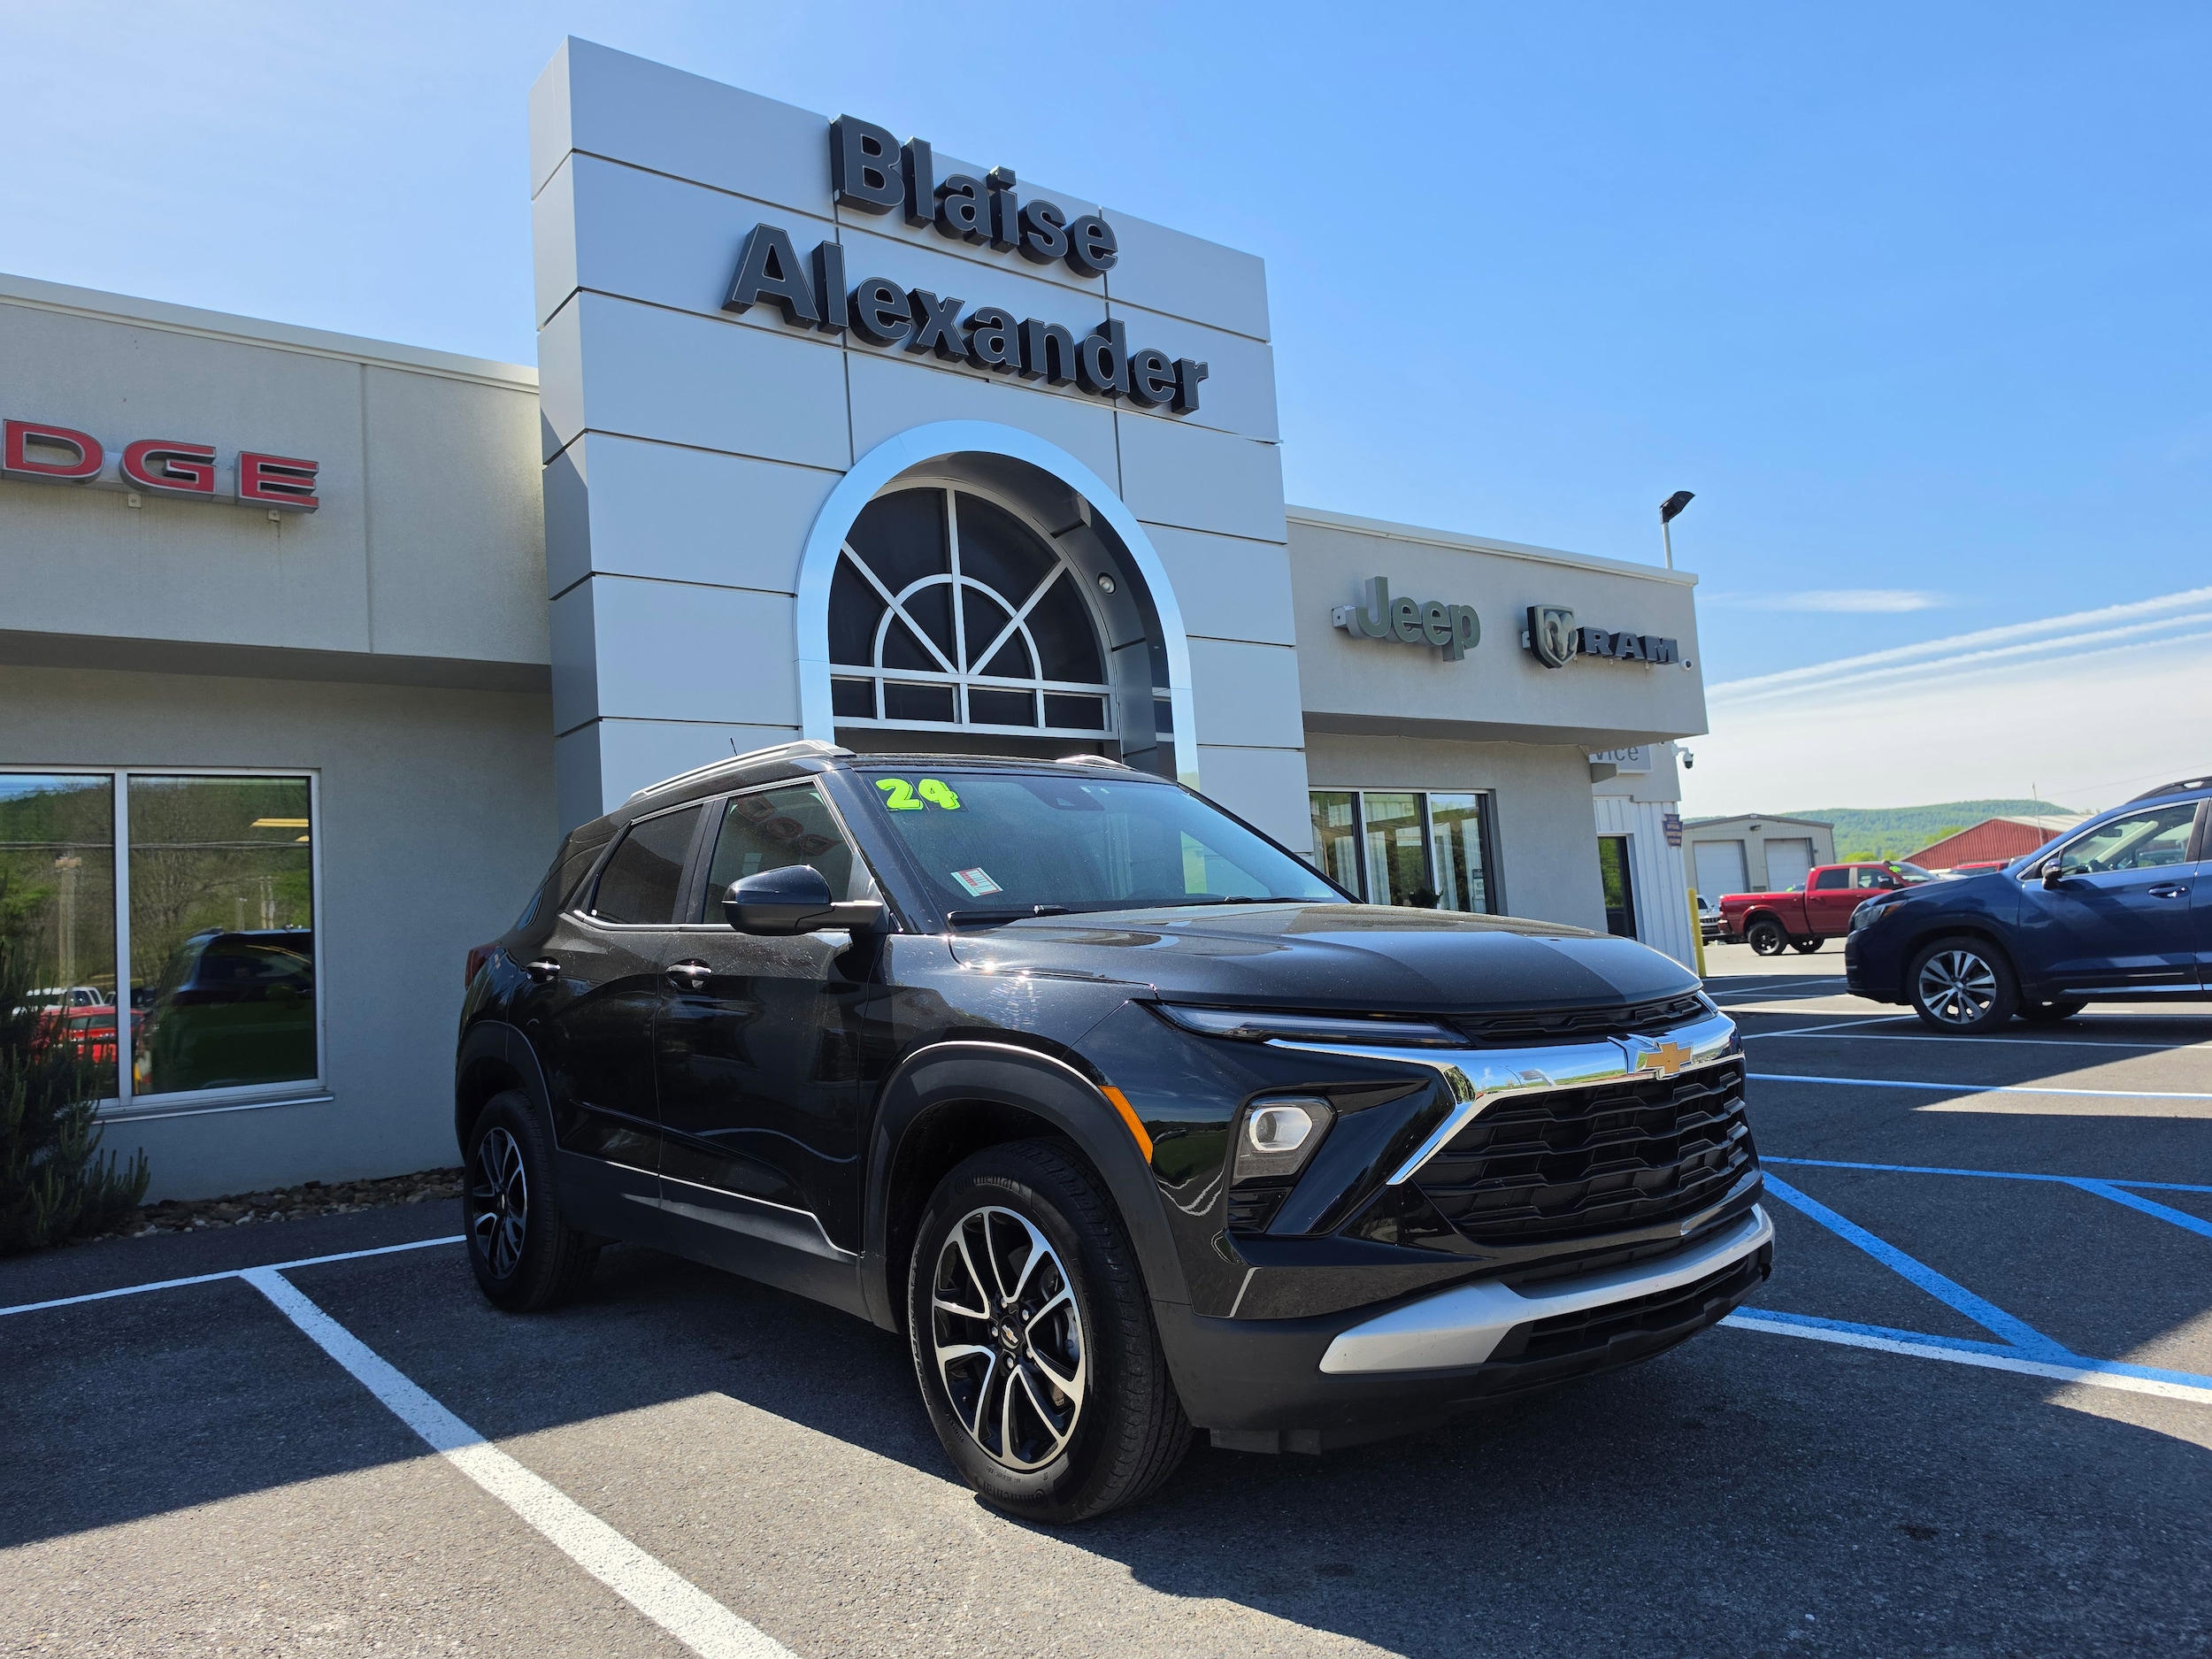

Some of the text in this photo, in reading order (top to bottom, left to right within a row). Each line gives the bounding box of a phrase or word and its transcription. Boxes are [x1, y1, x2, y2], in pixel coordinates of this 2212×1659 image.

[831, 113, 1118, 278] Blaise
[722, 223, 1209, 416] Alexander
[1348, 576, 1481, 662] Jeep
[1578, 626, 1679, 664] RAM
[876, 778, 961, 810] 24
